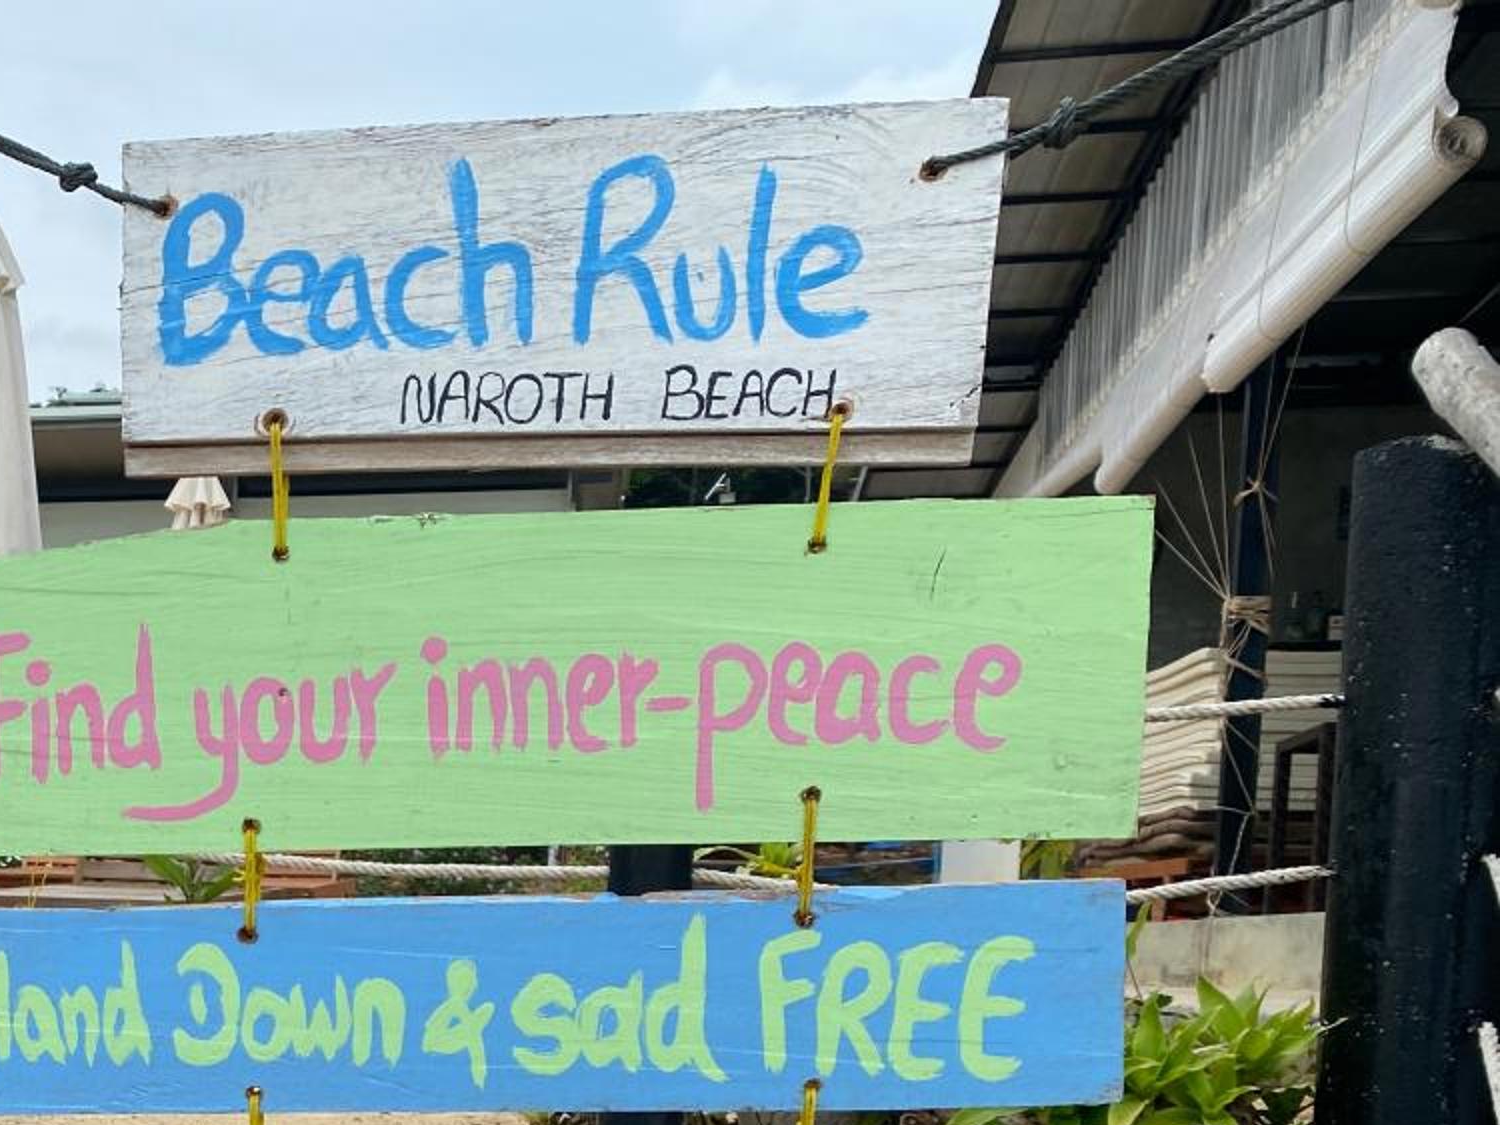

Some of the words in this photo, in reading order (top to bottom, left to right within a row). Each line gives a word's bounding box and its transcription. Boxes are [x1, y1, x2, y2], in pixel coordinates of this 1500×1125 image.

[158, 156, 534, 367] Beach
[572, 153, 871, 348] Rule
[400, 370, 615, 426] NAROTH
[662, 364, 839, 421] BEACH
[121, 660, 398, 821] your
[420, 635, 1022, 813] inner-peace
[422, 959, 494, 1087] &
[511, 914, 730, 1082] sad
[758, 930, 1035, 1081] FREE
